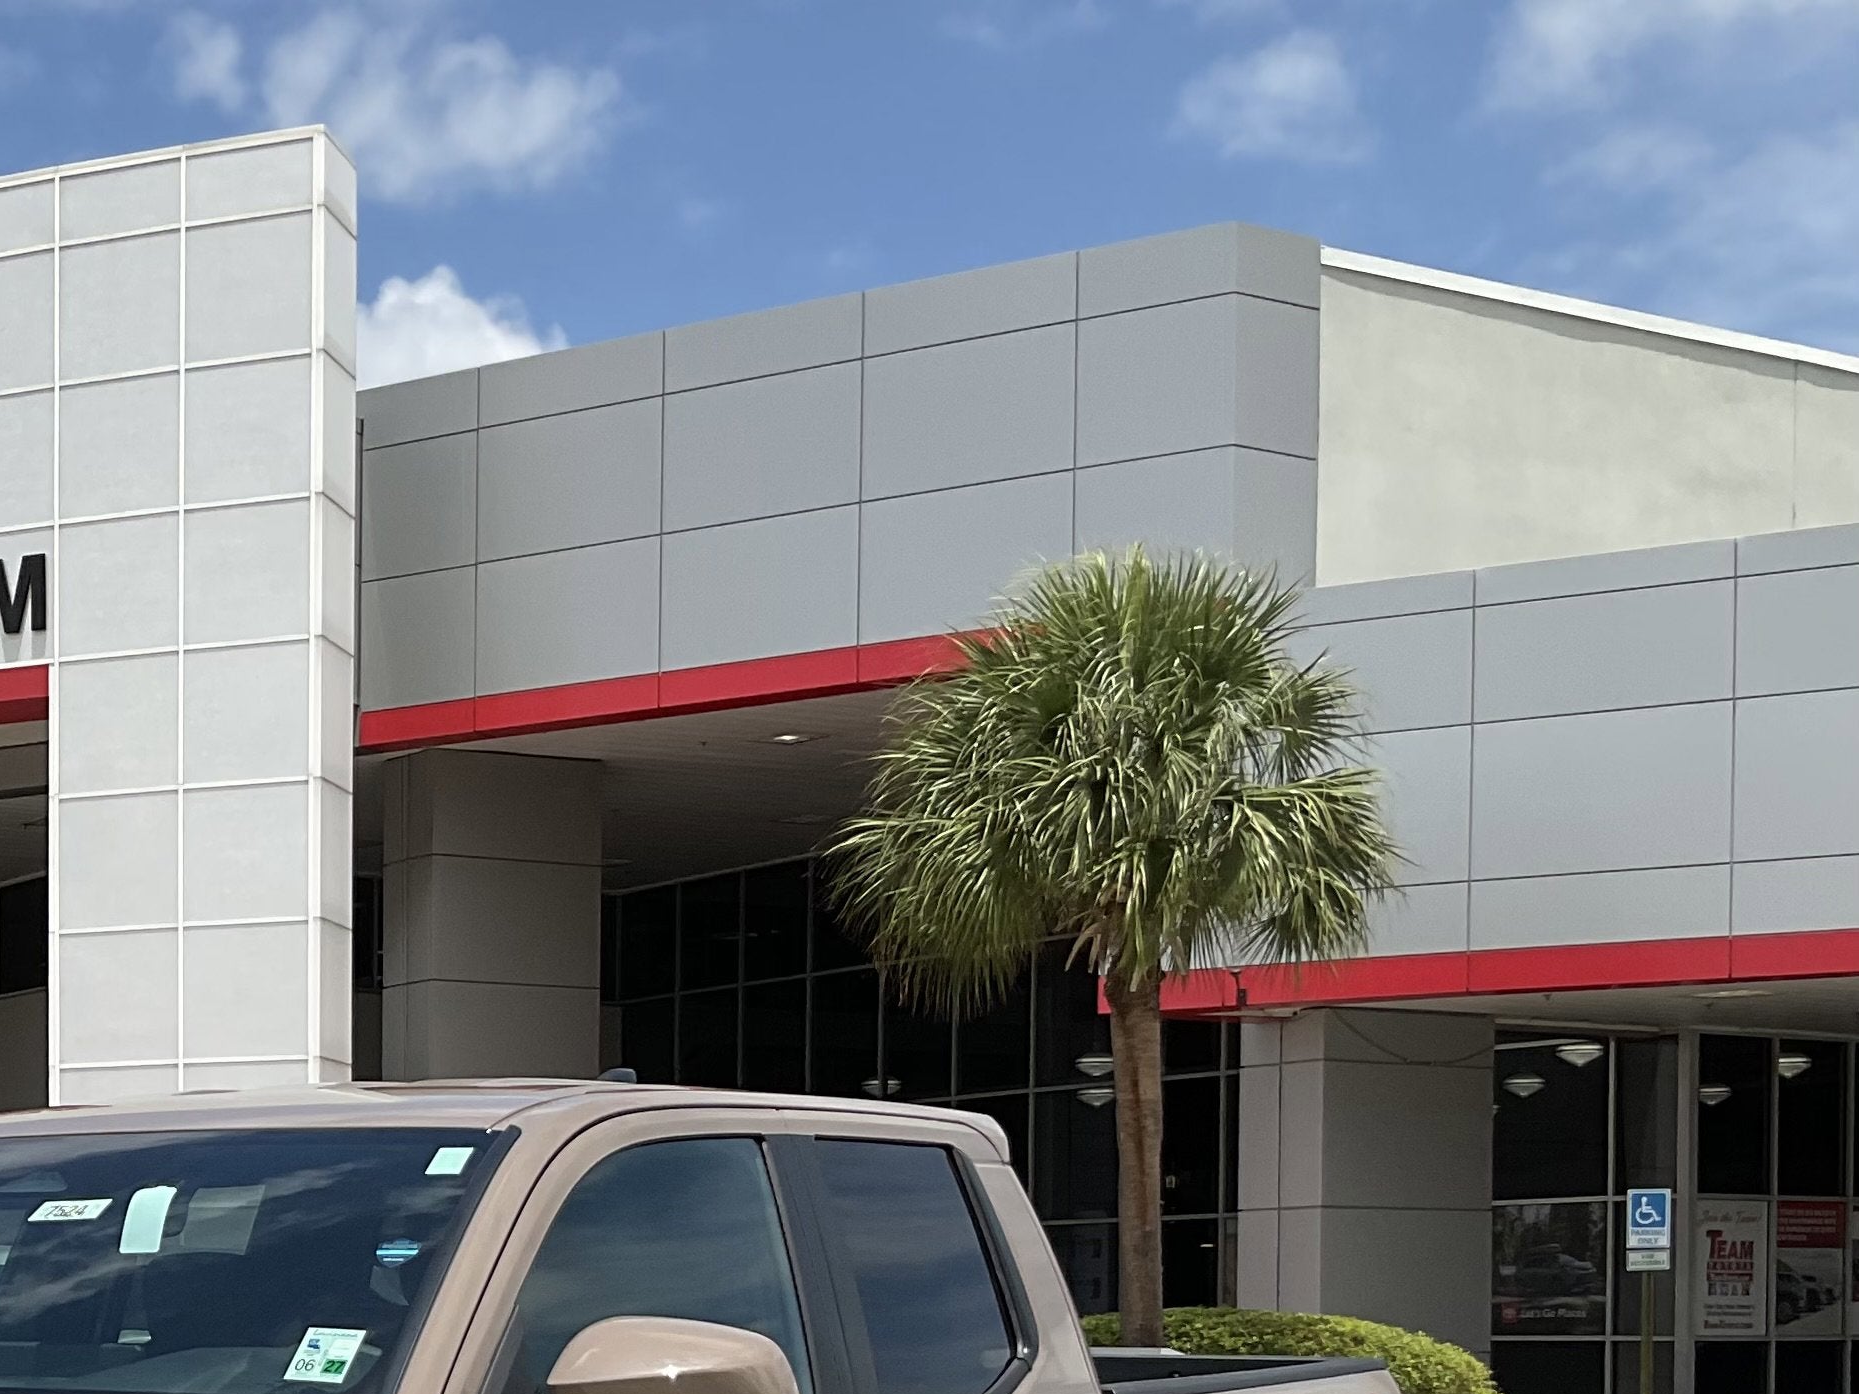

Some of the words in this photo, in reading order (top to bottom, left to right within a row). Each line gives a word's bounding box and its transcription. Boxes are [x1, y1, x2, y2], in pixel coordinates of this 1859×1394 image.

[43, 1204, 87, 1218] 7524
[1636, 1237, 1659, 1245] ONLY
[1705, 1229, 1755, 1260] TEAM
[294, 1358, 315, 1372] 06
[323, 1359, 346, 1373] 27
